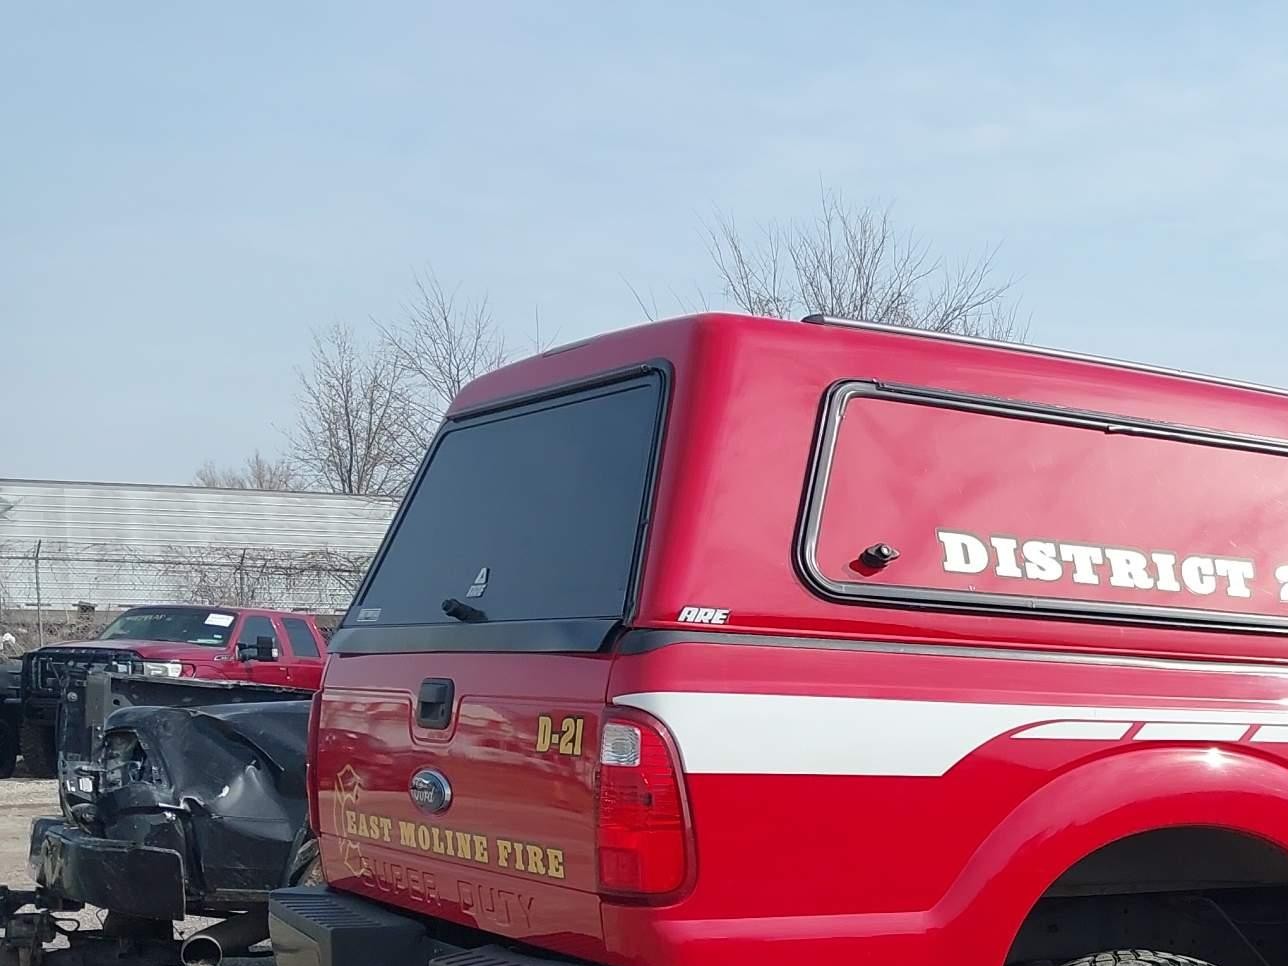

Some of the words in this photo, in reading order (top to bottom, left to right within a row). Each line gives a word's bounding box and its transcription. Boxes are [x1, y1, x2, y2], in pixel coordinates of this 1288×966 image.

[936, 527, 1255, 599] DISTRICT
[677, 606, 730, 625] ARE
[535, 715, 585, 756] D-21
[346, 810, 392, 842] EAST
[399, 820, 489, 864] MOLINE
[497, 838, 566, 879] FIRE
[360, 855, 443, 906] SUPER
[456, 880, 535, 929] DUTY
